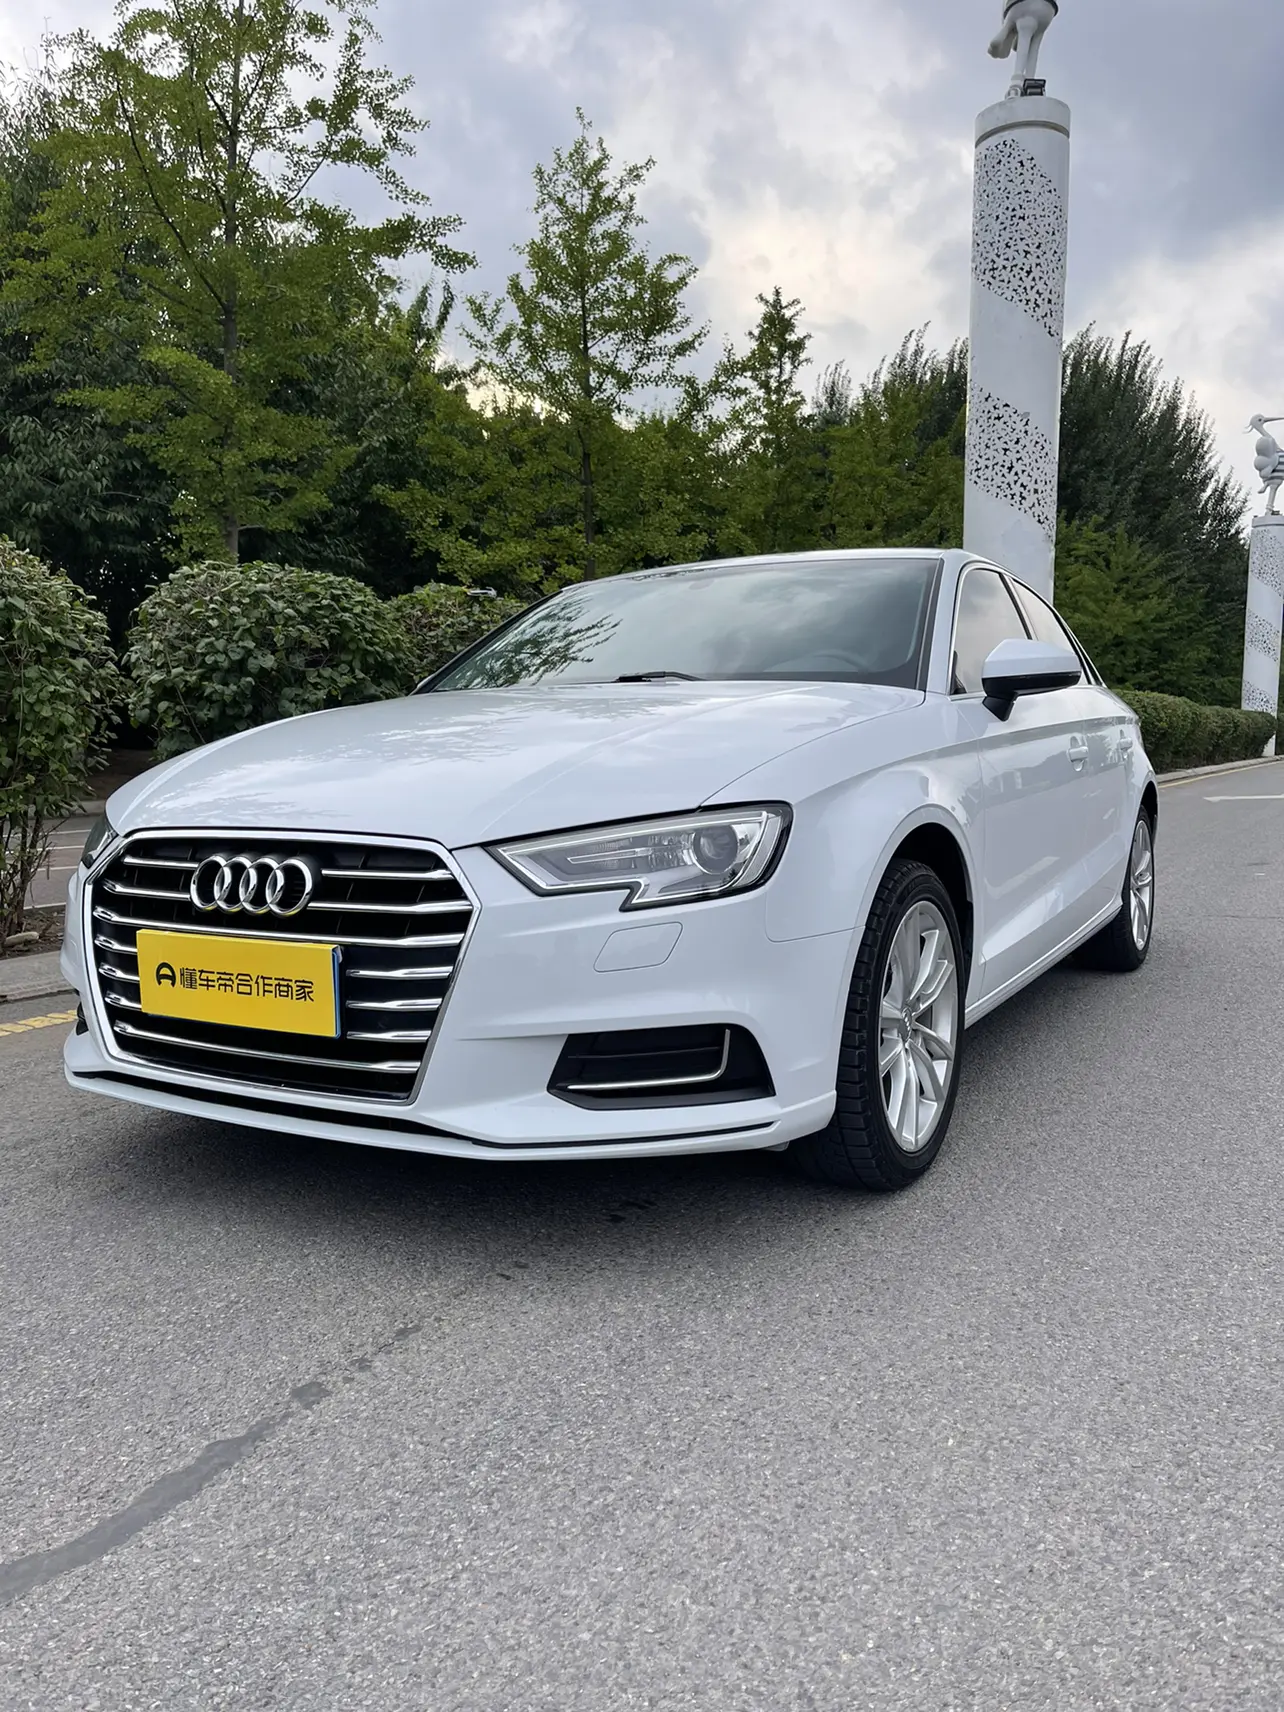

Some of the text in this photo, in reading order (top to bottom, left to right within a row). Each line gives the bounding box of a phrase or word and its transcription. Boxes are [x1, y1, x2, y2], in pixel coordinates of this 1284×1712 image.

[179, 967, 315, 1002] 懂车帝合作商家
